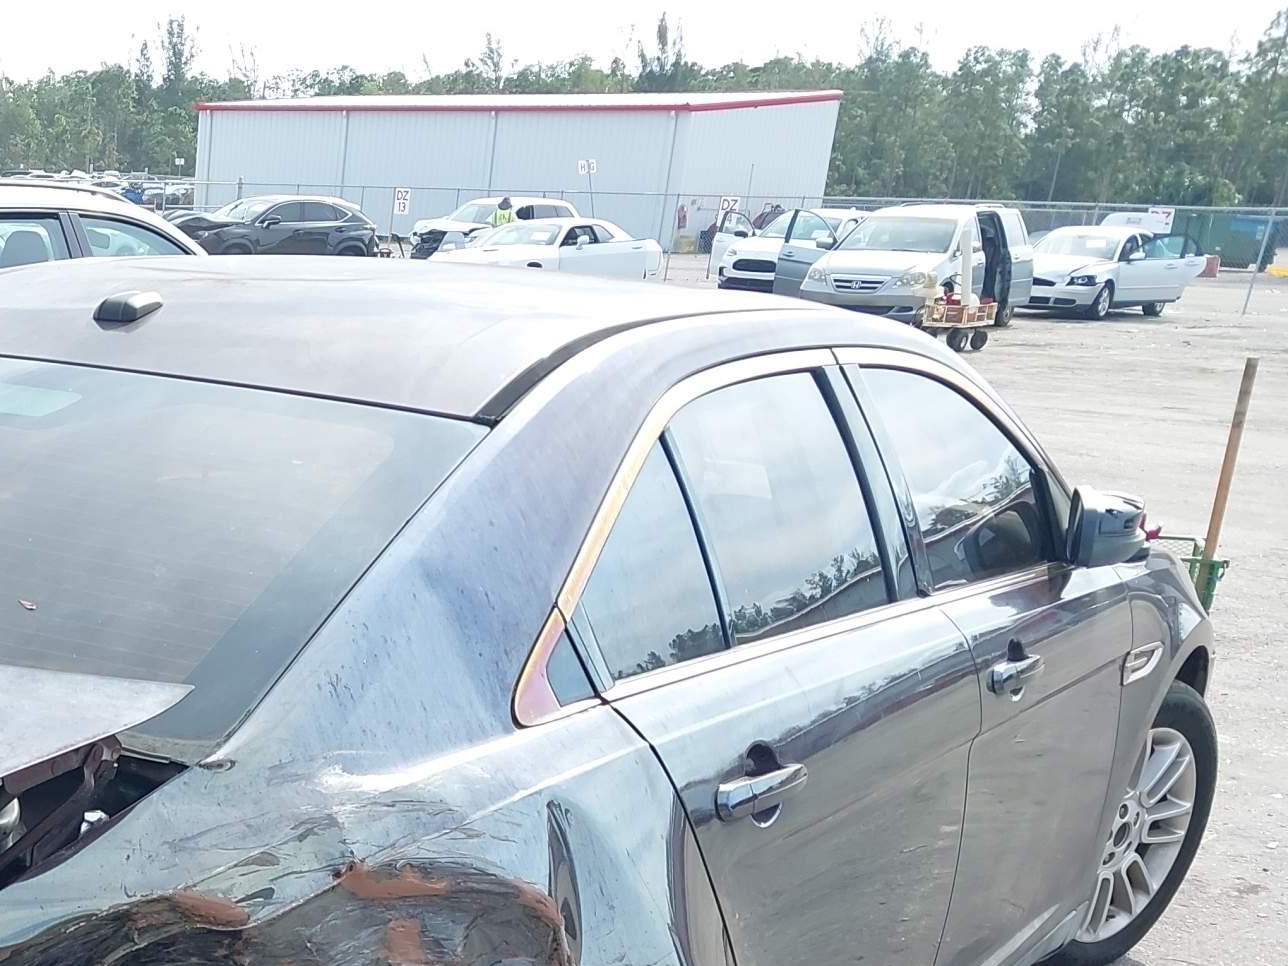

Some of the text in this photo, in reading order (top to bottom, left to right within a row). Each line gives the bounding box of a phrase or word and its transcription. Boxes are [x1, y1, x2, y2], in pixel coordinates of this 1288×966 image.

[396, 189, 410, 201] DZ
[398, 202, 406, 213] 13
[721, 198, 738, 211] DZ
